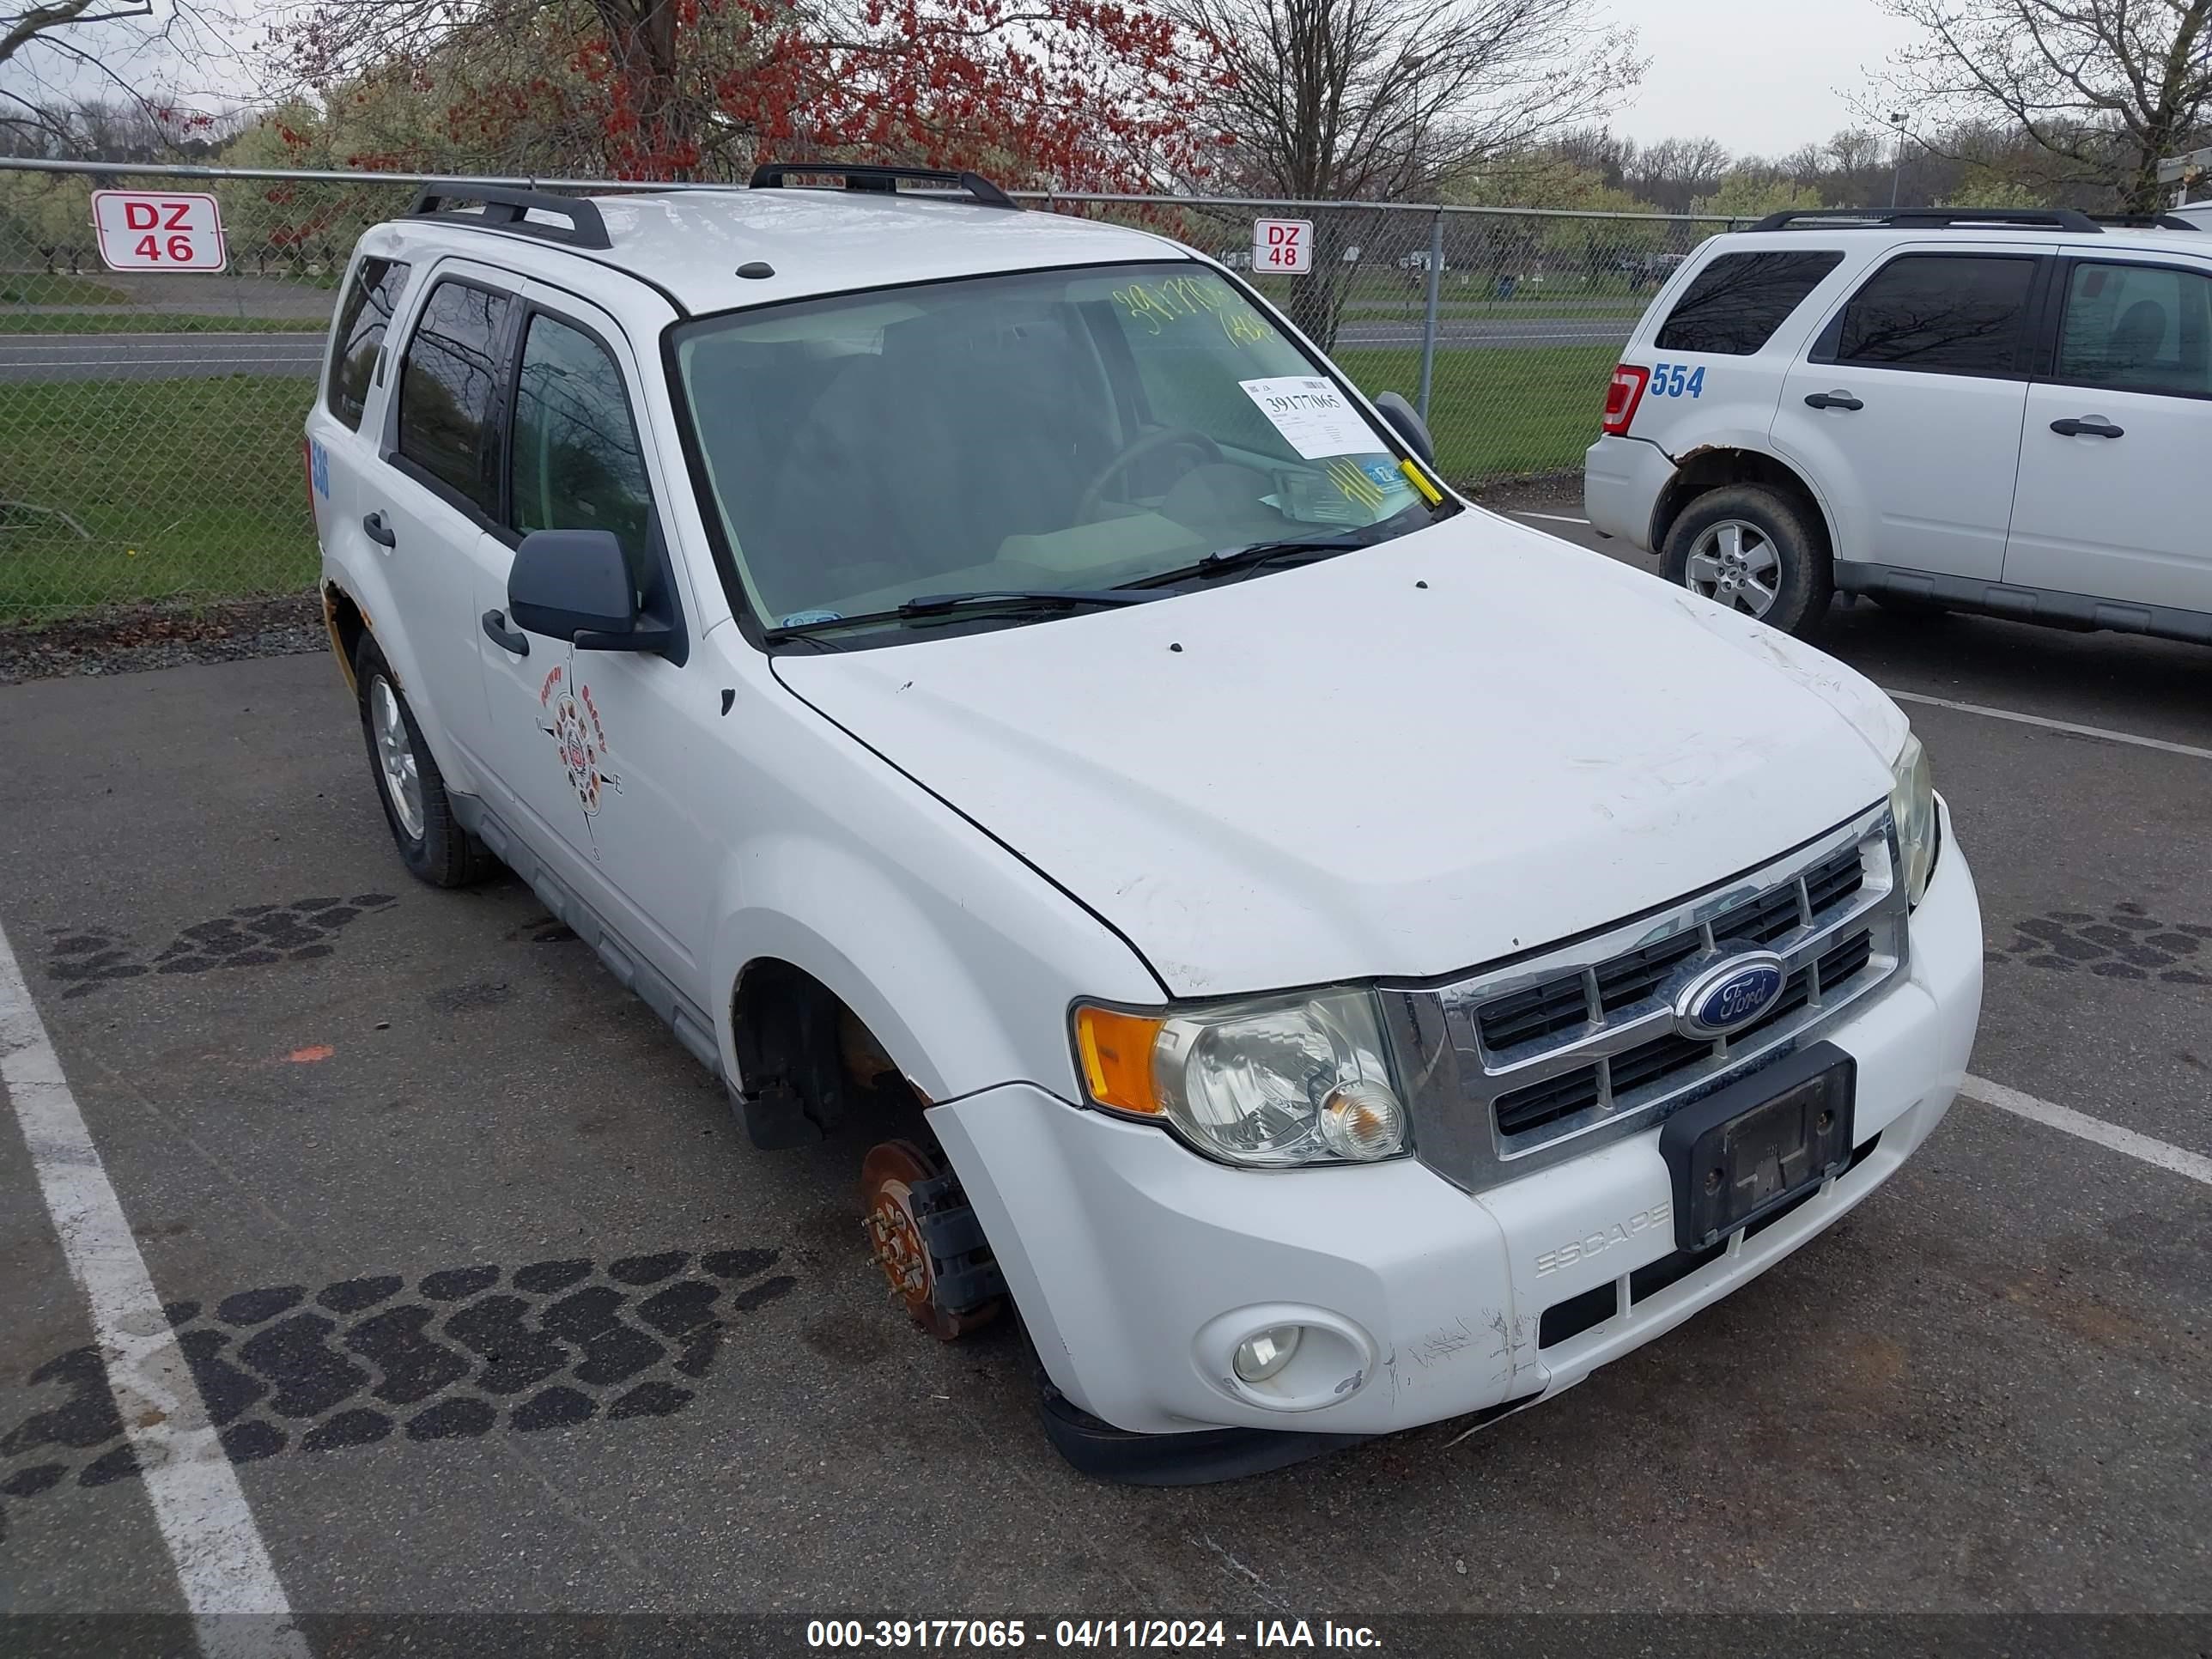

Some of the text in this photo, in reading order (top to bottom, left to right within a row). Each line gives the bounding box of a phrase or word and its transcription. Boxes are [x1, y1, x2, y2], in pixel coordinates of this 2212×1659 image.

[125, 203, 193, 231] DZ
[135, 234, 193, 261] 46
[1268, 226, 1300, 246] DZ
[1268, 247, 1297, 266] 48
[1650, 363, 1705, 398] 554
[1266, 393, 1340, 413] 39177065
[1720, 976, 1766, 1020] Ford
[1535, 1200, 1670, 1279] ESCAPE
